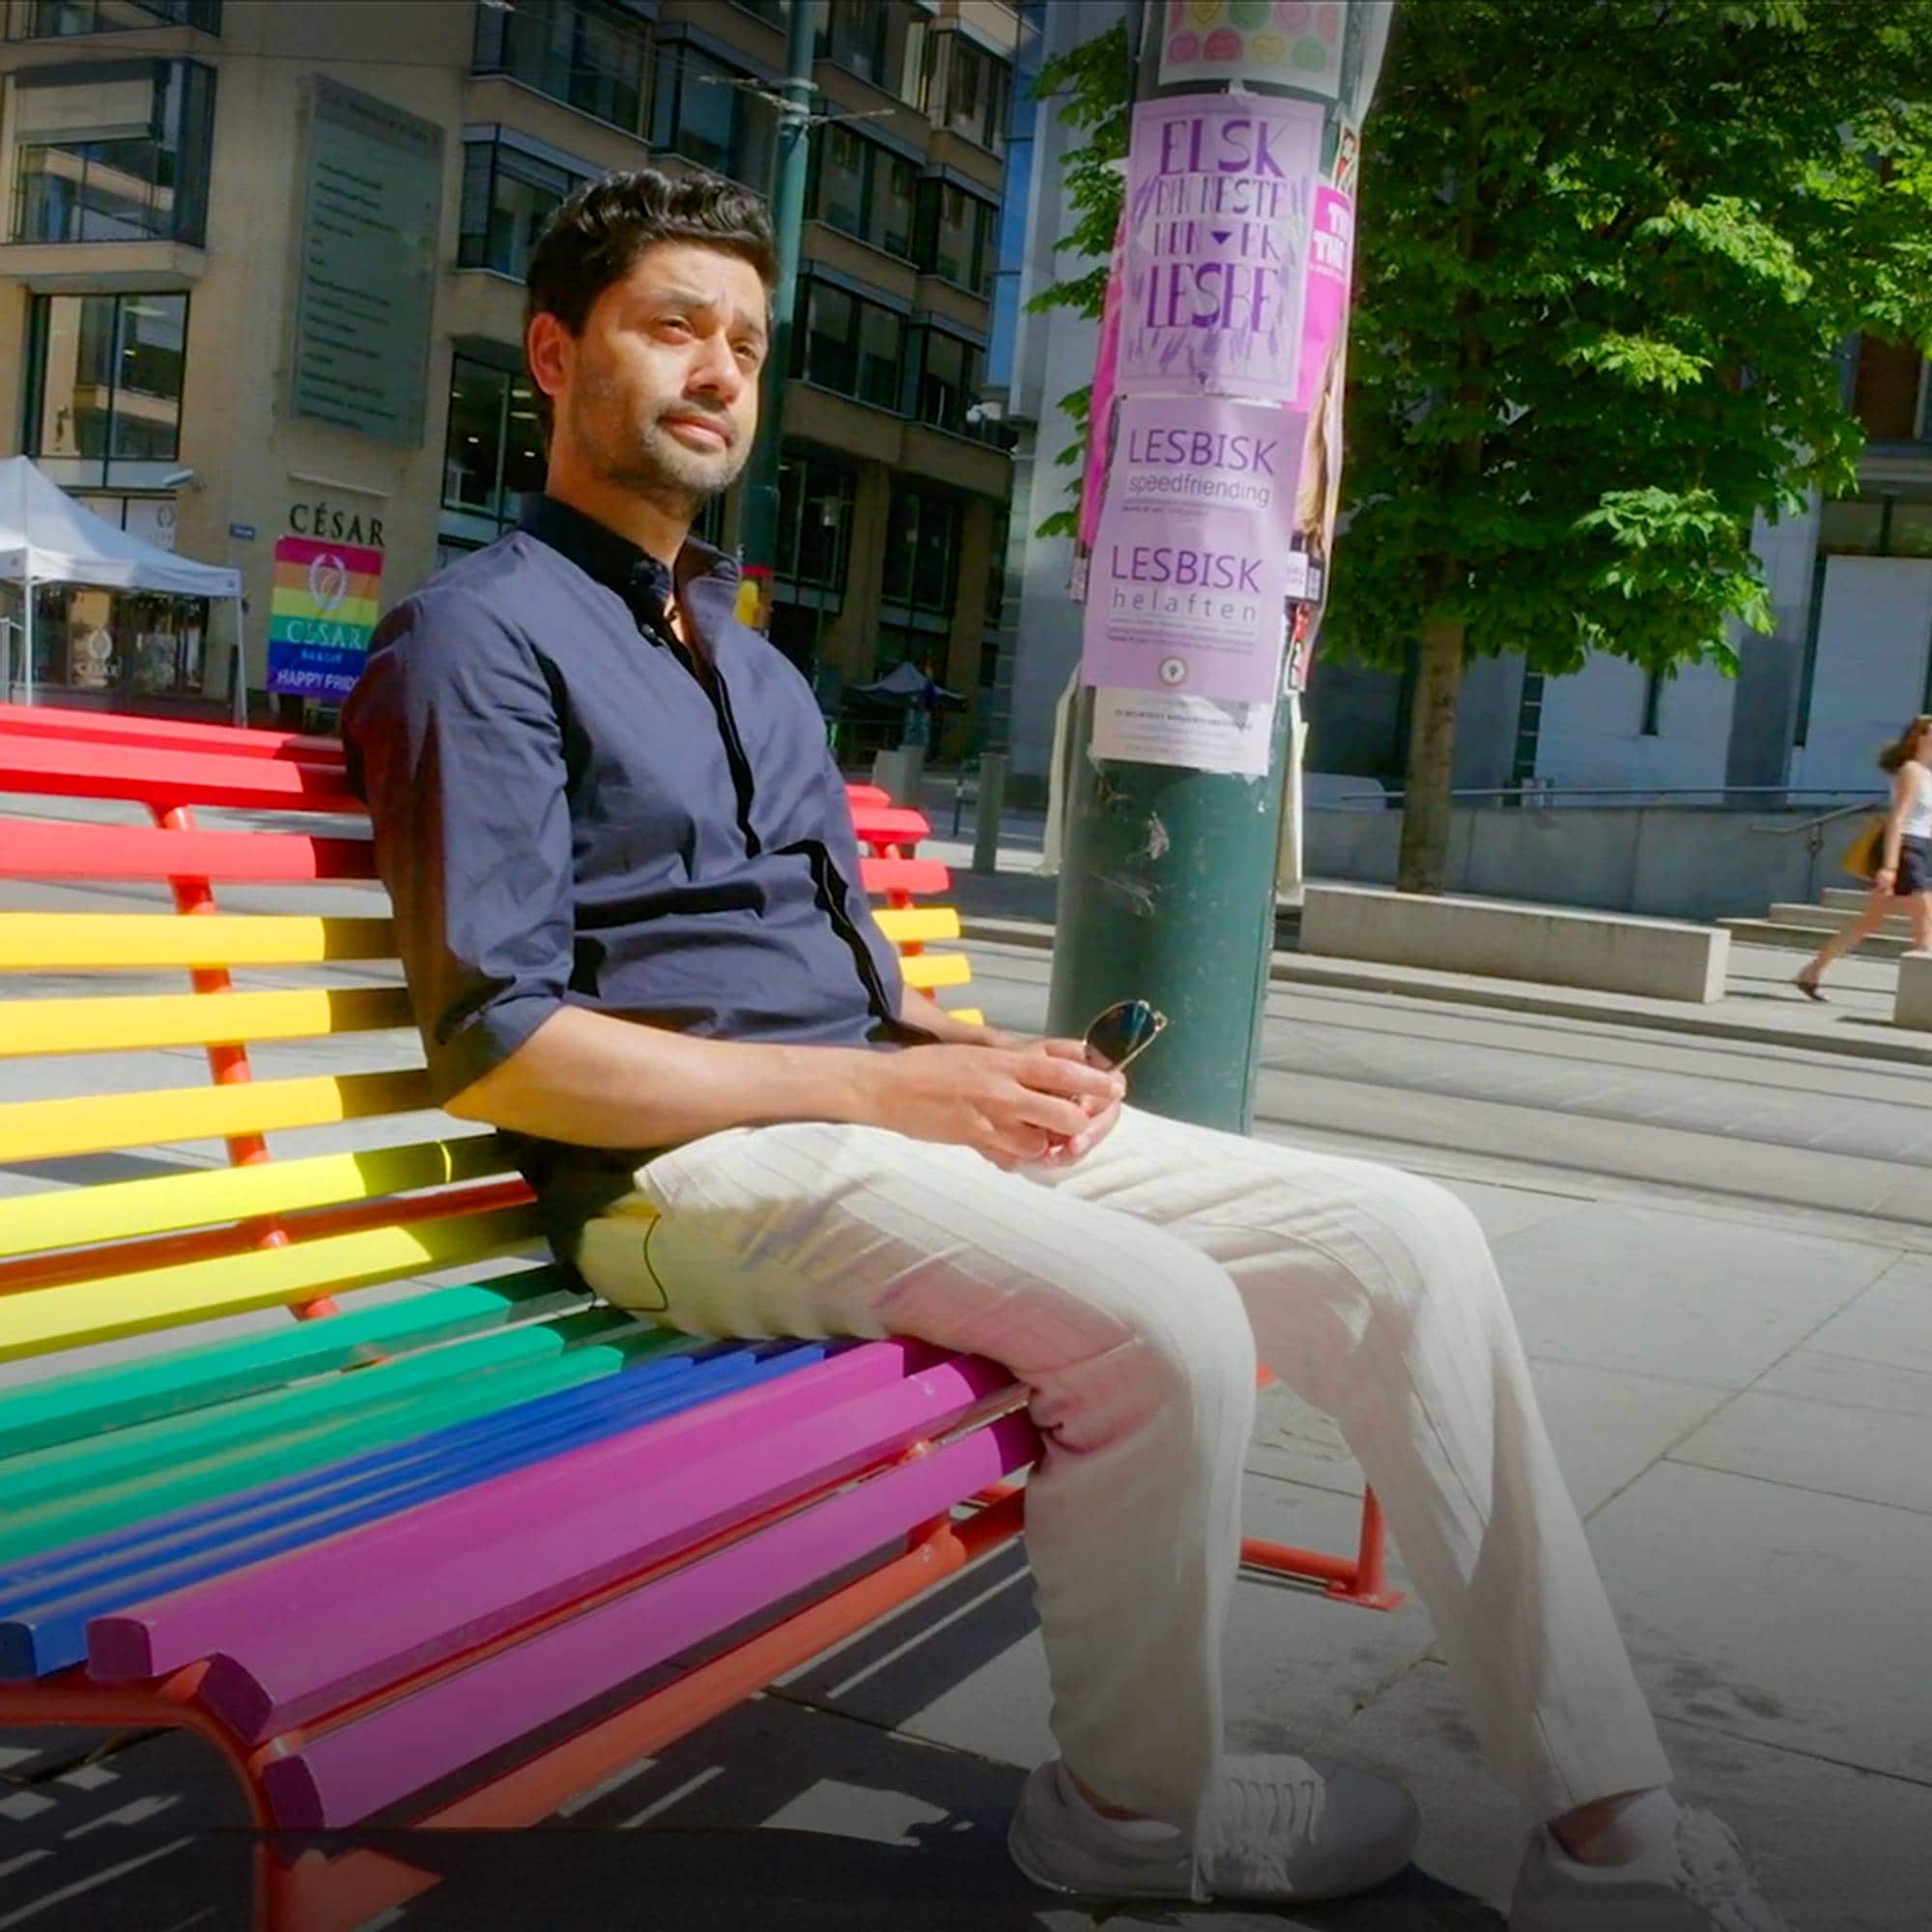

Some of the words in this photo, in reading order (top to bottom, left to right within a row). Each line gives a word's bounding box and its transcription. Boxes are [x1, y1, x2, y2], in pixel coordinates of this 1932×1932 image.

[1160, 120, 1286, 177] ELSK
[1128, 428, 1279, 476] LESBISK
[1128, 473, 1270, 508] speedfriending
[289, 501, 386, 548] CÉSAR
[1111, 544, 1263, 594] LESBISK
[1112, 586, 1257, 622] helaften
[277, 668, 324, 689] HAPPY
